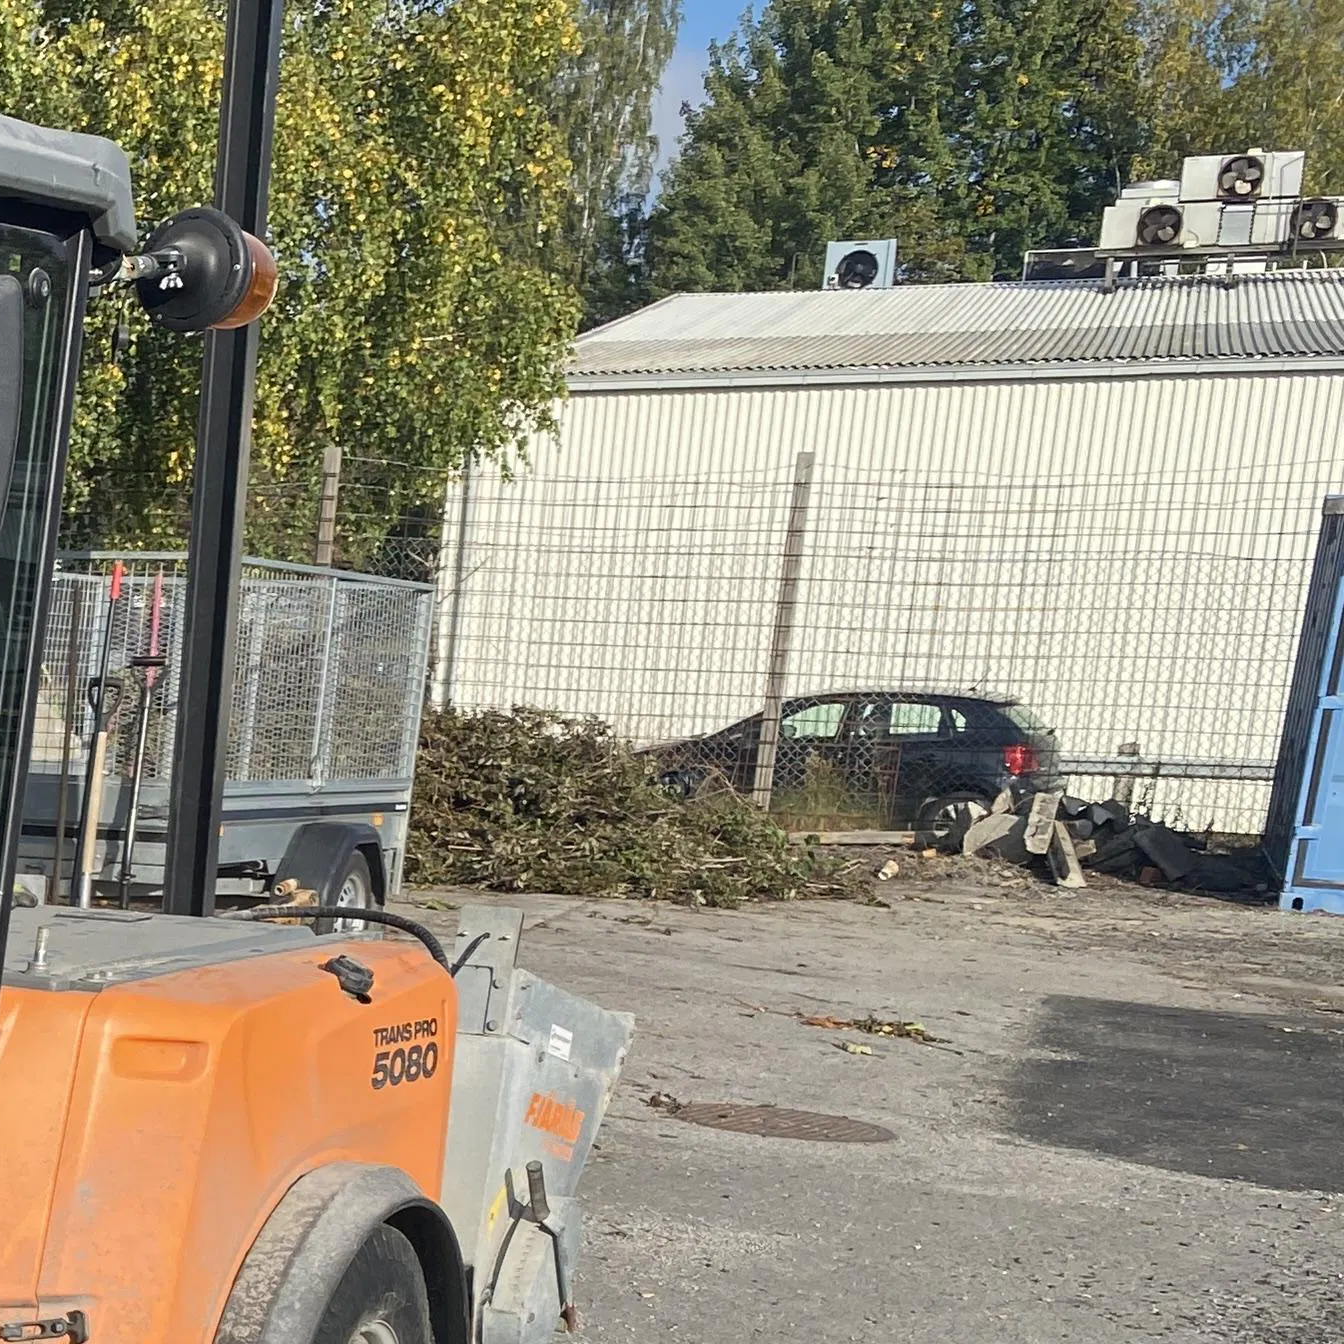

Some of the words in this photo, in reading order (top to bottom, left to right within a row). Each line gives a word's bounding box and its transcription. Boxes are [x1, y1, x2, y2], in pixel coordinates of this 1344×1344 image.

[373, 1023, 413, 1047] TRANS
[413, 1018, 438, 1040] PRO
[371, 1041, 439, 1090] 5080
